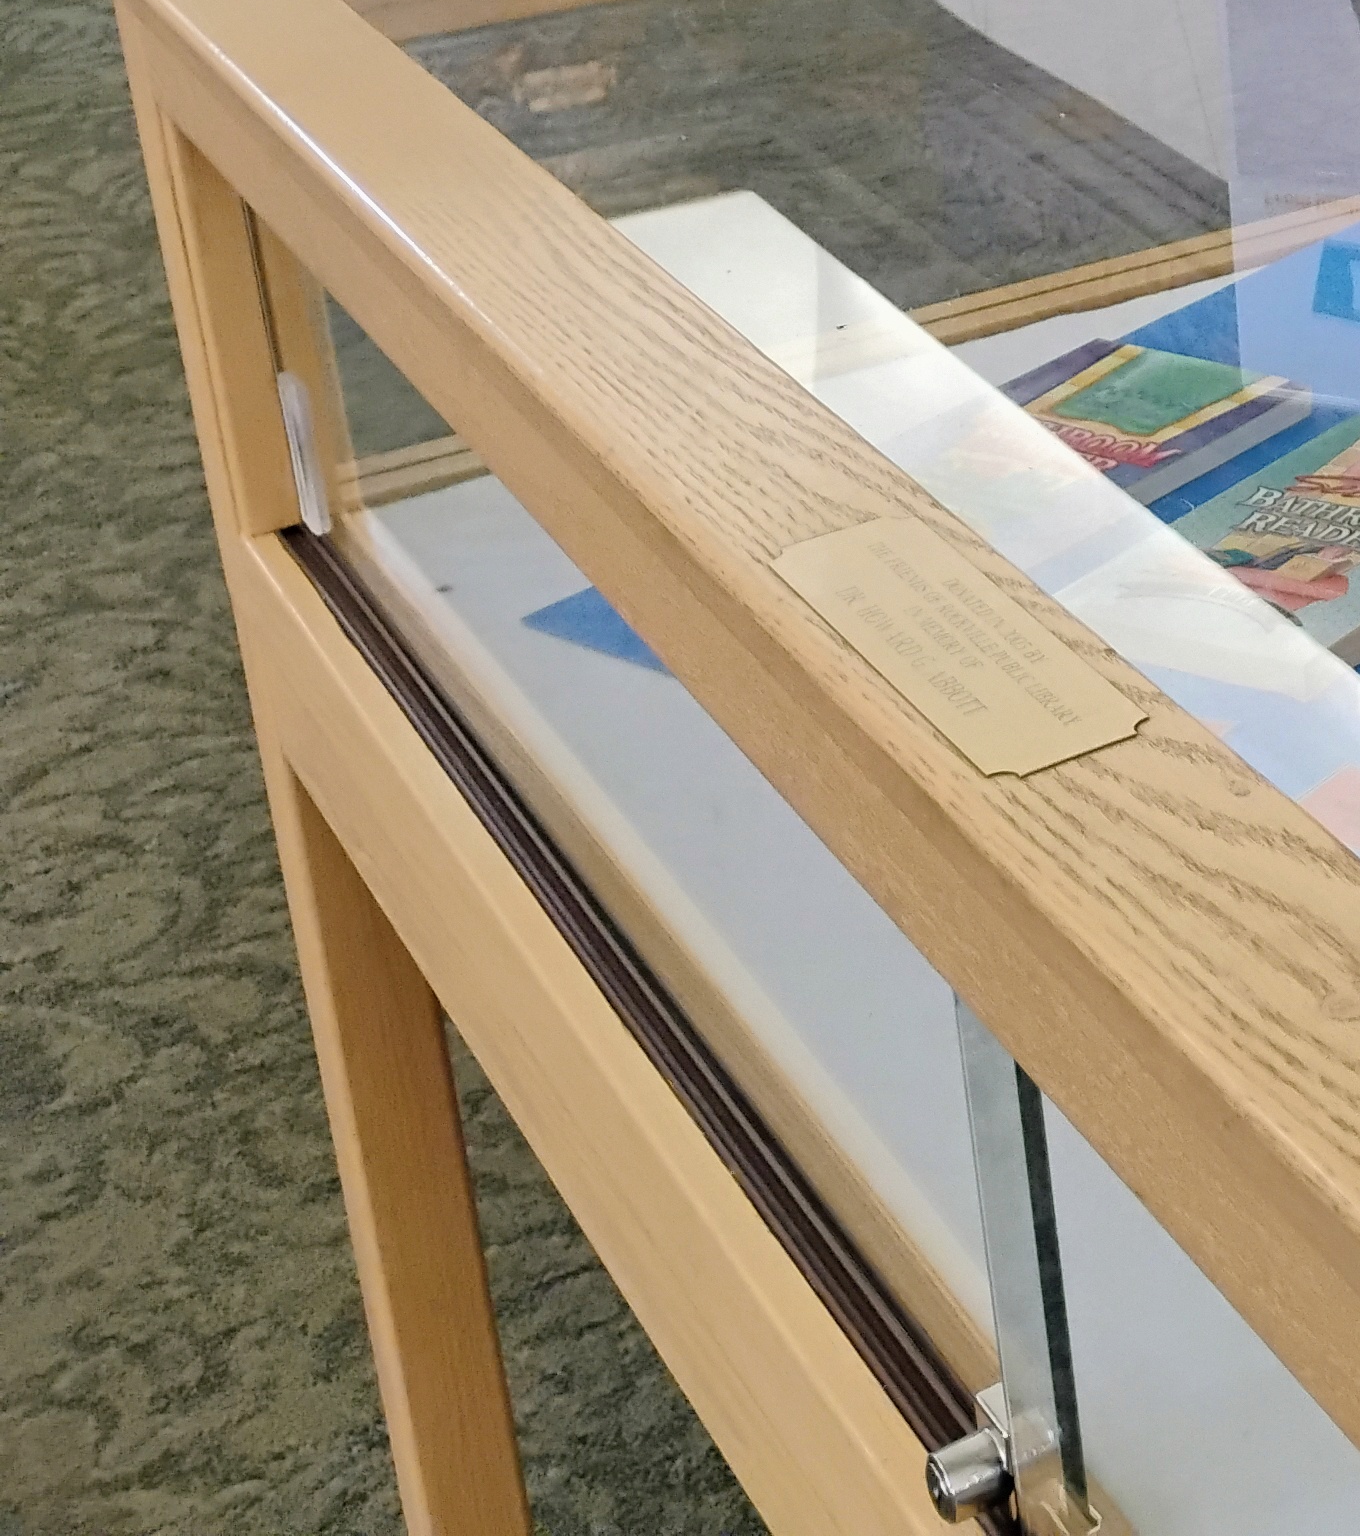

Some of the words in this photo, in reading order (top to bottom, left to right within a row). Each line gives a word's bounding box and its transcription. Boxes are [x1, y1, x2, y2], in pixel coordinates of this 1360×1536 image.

[887, 560, 927, 592] FRIENDS
[990, 642, 1034, 686] PUBLIC
[1024, 683, 1082, 727] LIBRARY
[919, 615, 967, 658] MEMORY
[928, 671, 989, 717] ABBOTT
